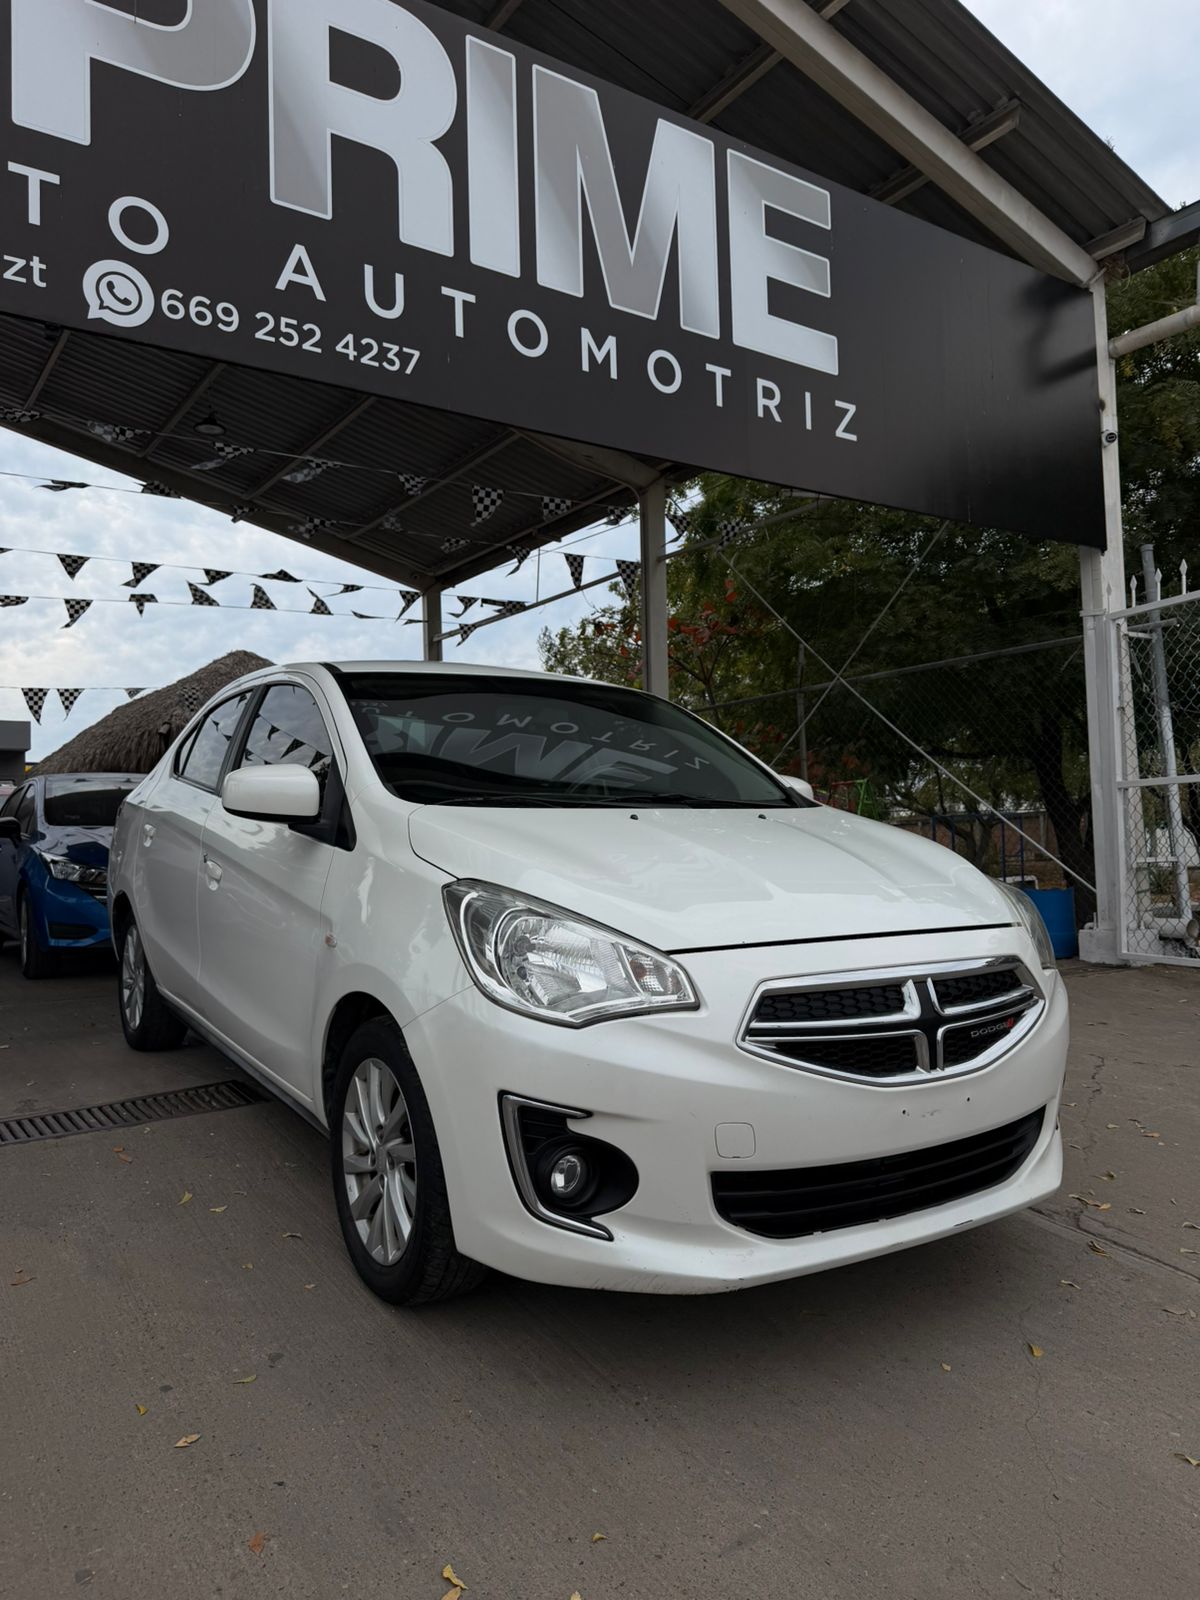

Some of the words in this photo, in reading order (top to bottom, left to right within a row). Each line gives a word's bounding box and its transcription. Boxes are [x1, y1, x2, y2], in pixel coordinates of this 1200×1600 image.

[161, 289, 240, 332] 669
[255, 312, 323, 353] 252
[336, 334, 421, 375] 4237
[275, 244, 858, 442] AUTOMOTRIZ
